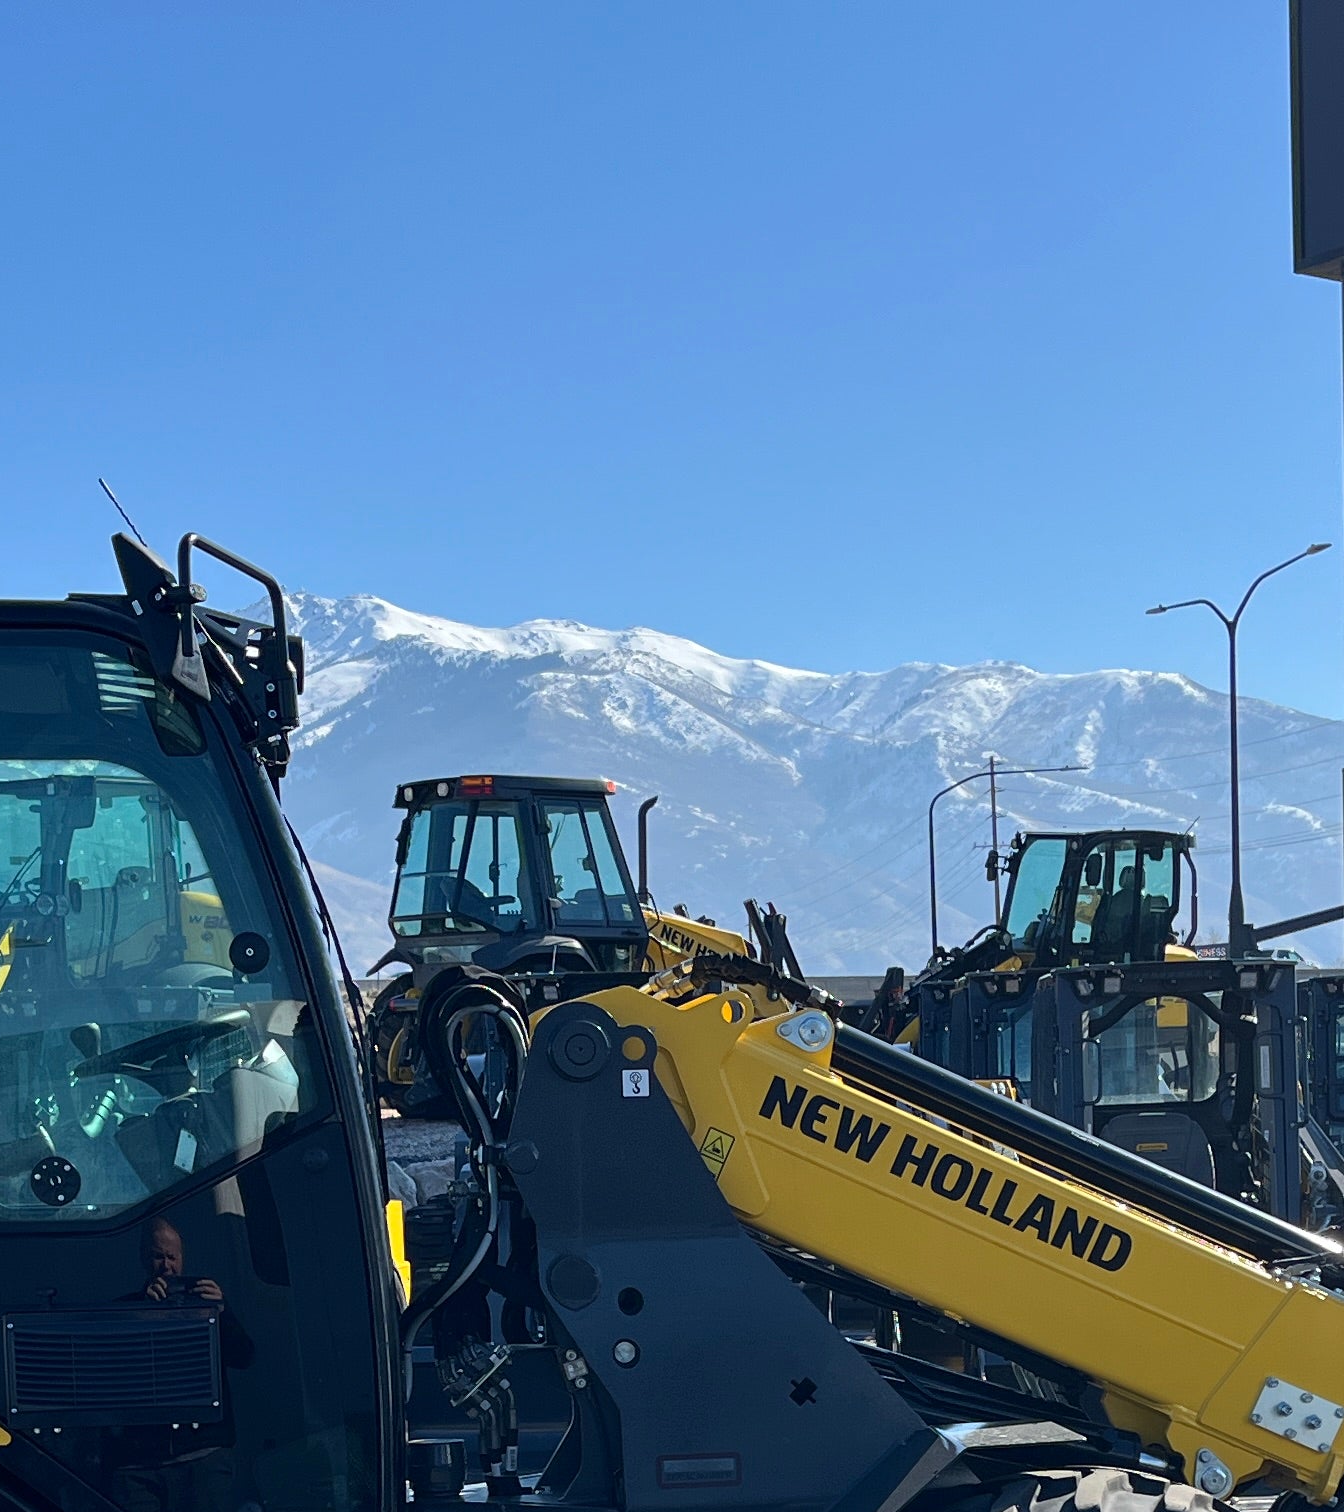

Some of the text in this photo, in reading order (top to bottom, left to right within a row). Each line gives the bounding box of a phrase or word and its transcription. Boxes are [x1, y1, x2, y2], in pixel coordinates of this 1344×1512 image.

[660, 923, 695, 953] NEW
[759, 1075, 1133, 1272] NEW HOLLAND
